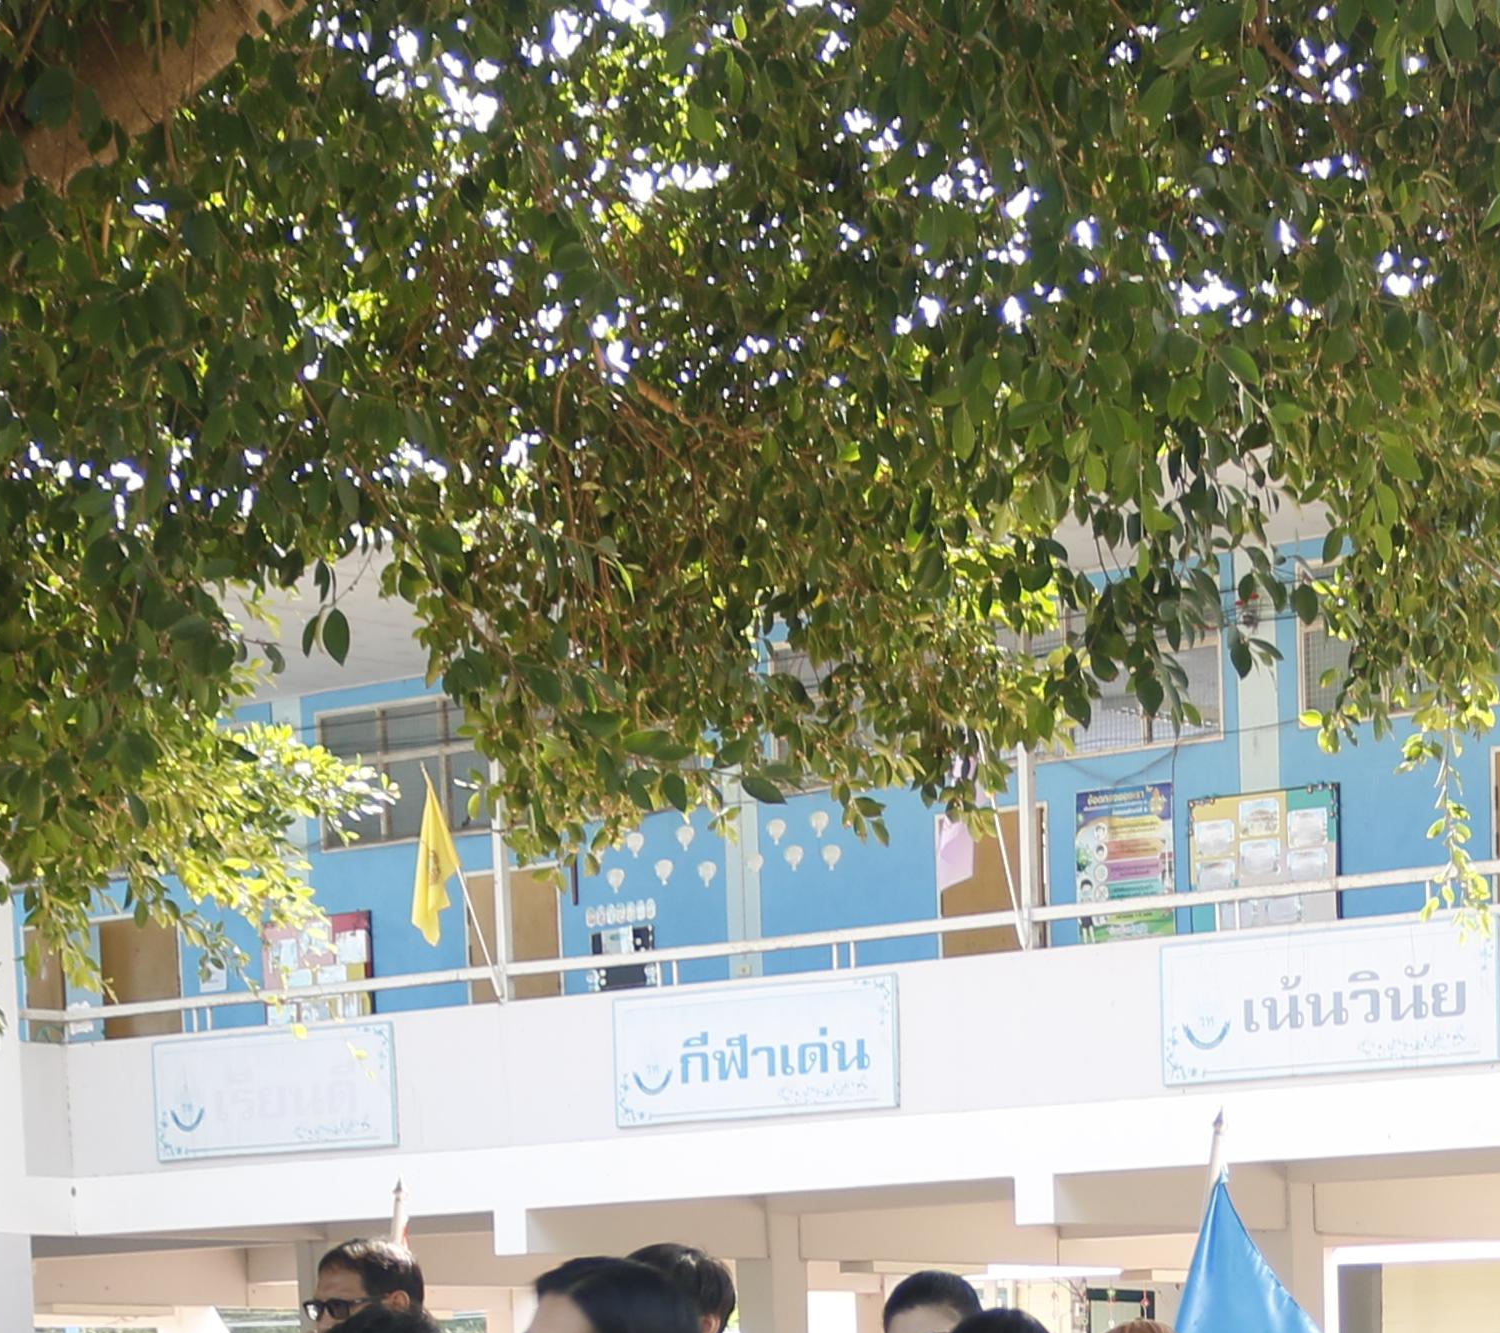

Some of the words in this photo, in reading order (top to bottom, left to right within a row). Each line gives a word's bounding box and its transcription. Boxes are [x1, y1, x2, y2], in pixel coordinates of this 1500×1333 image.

[1243, 962, 1467, 1033] เน้นวินัย
[680, 1027, 870, 1084] กีฬาเด่น
